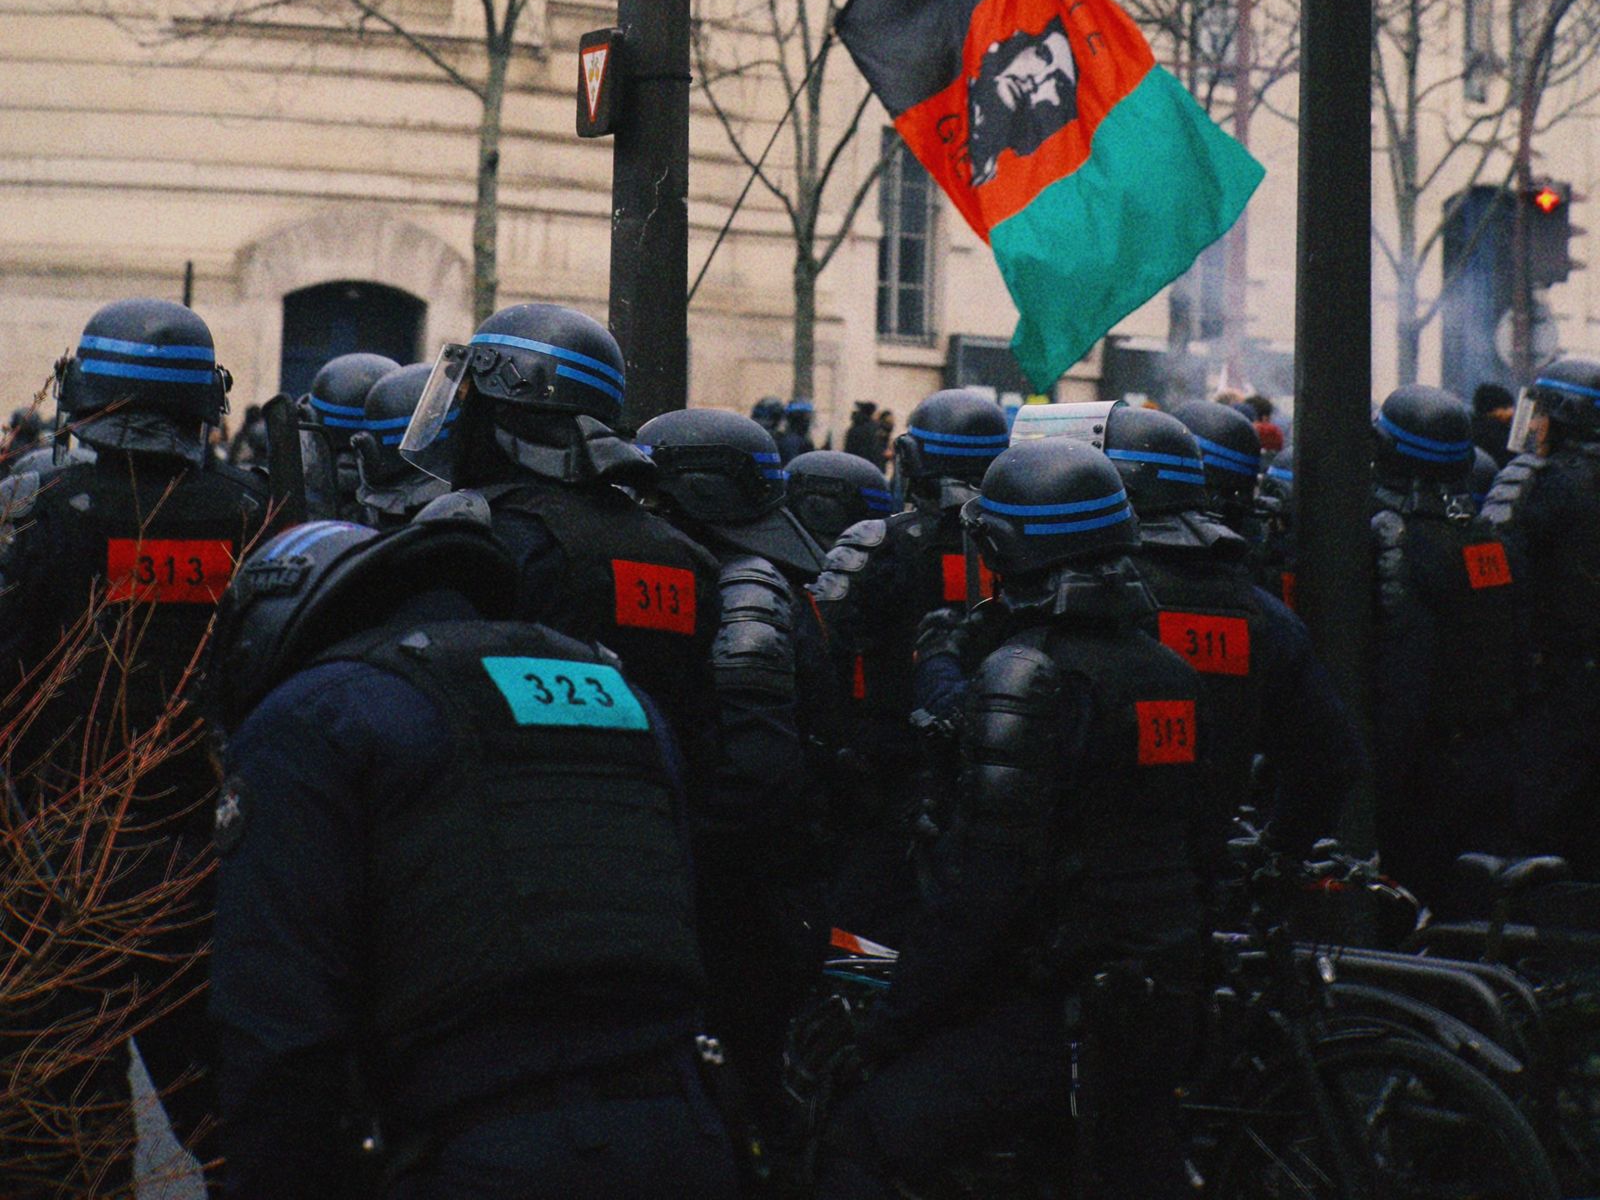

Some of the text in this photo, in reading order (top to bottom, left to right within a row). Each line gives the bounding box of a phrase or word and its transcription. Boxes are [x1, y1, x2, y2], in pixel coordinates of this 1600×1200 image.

[138, 555, 205, 586] 313
[635, 579, 681, 615] 313
[1185, 628, 1227, 658] 311
[523, 673, 615, 708] 323
[1151, 717, 1187, 748] 313
